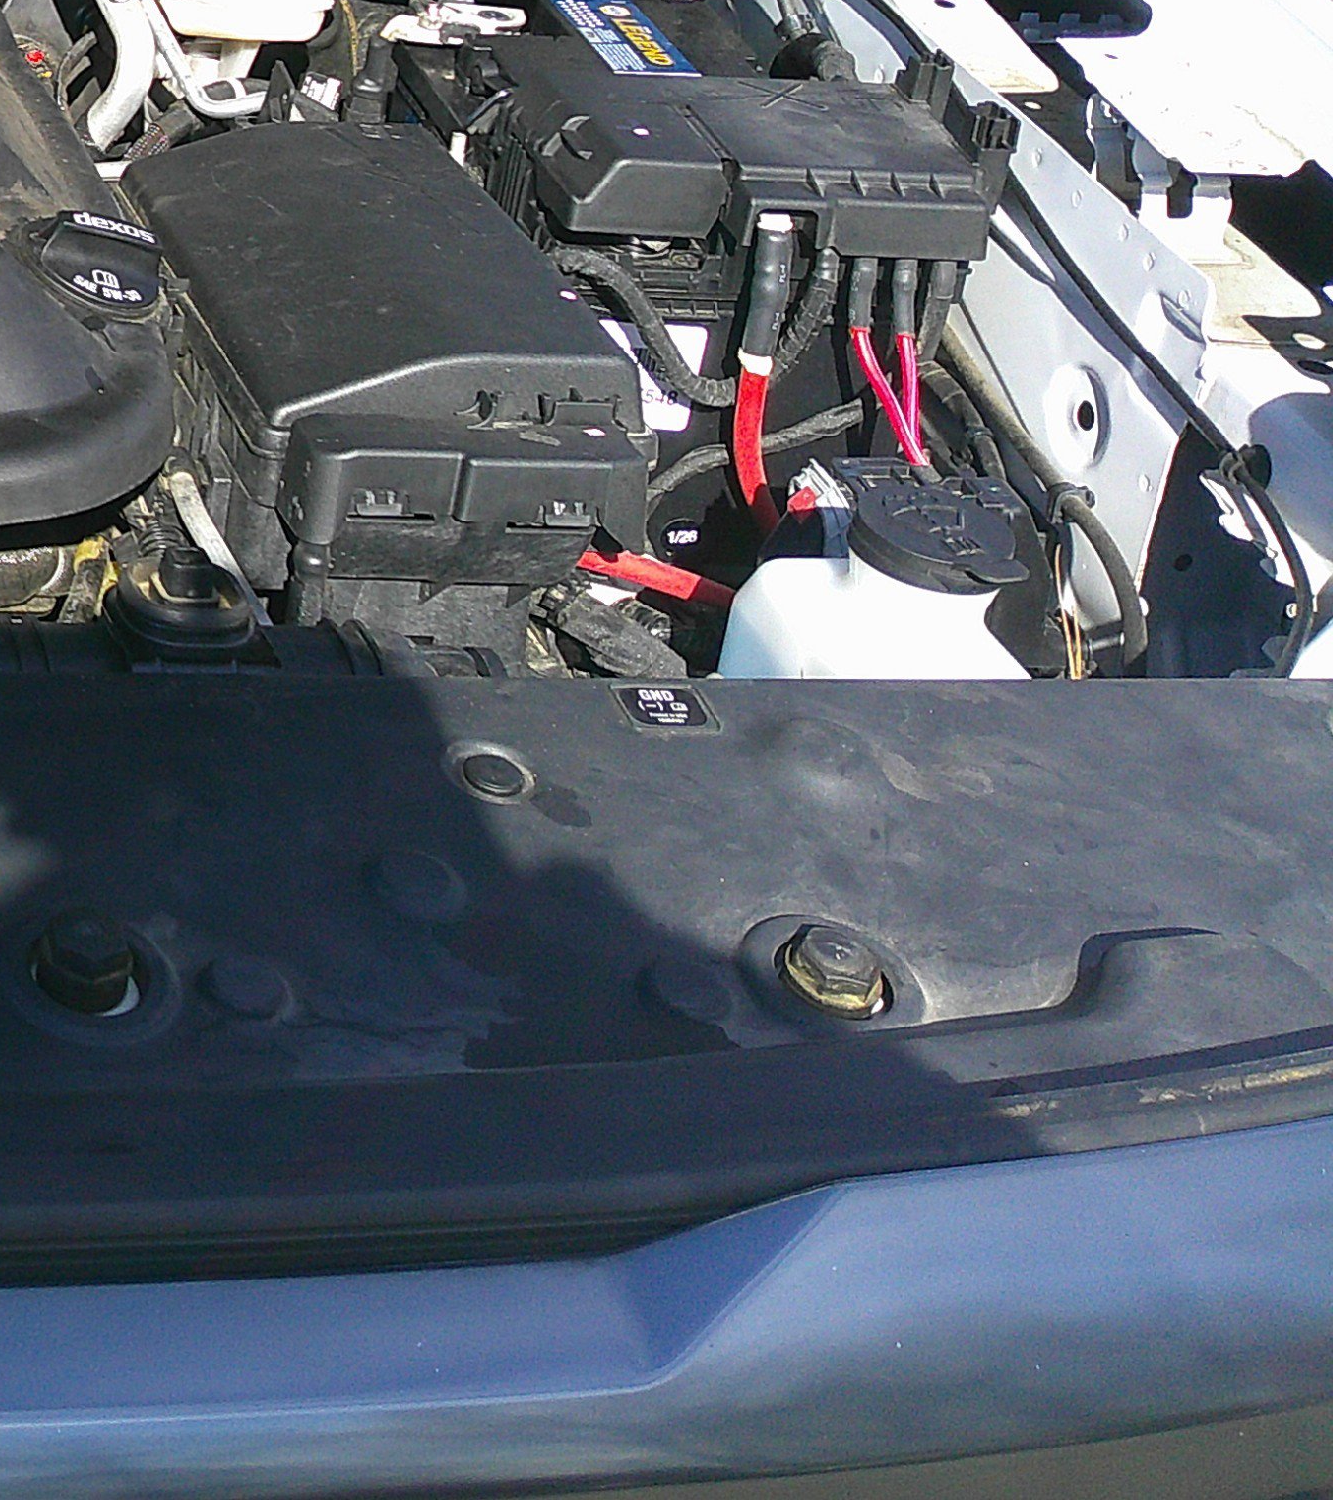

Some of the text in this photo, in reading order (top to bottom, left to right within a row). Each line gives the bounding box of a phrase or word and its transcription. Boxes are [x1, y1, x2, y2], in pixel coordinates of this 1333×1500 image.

[611, 18, 675, 67] LEGEND
[73, 212, 155, 243] dexos
[73, 274, 98, 293] SAE
[638, 689, 675, 701] GND
